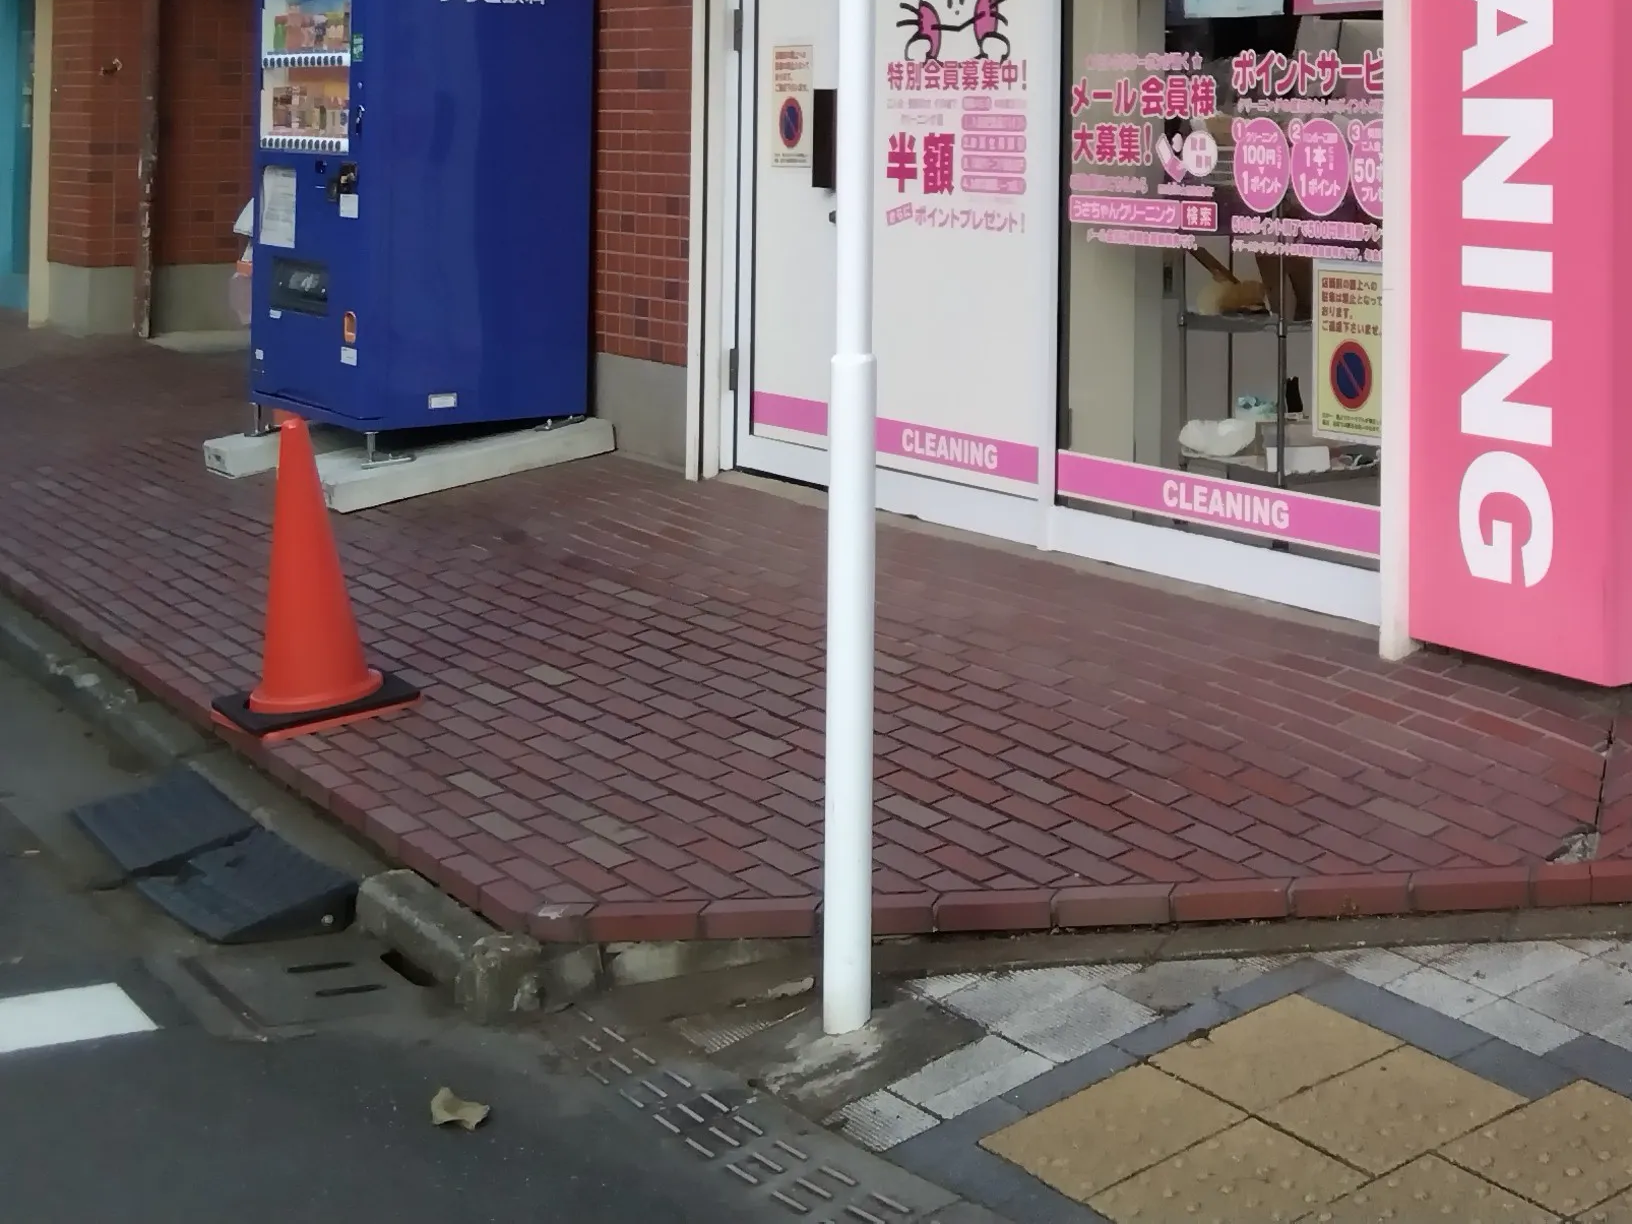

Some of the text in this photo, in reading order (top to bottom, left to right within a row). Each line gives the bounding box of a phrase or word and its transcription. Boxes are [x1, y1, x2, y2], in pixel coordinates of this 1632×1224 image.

[886, 59, 1028, 91] 特別会員募集中!
[886, 131, 956, 196] 半額
[901, 428, 999, 471] CLEANING
[1162, 479, 1290, 530] CLEANING
